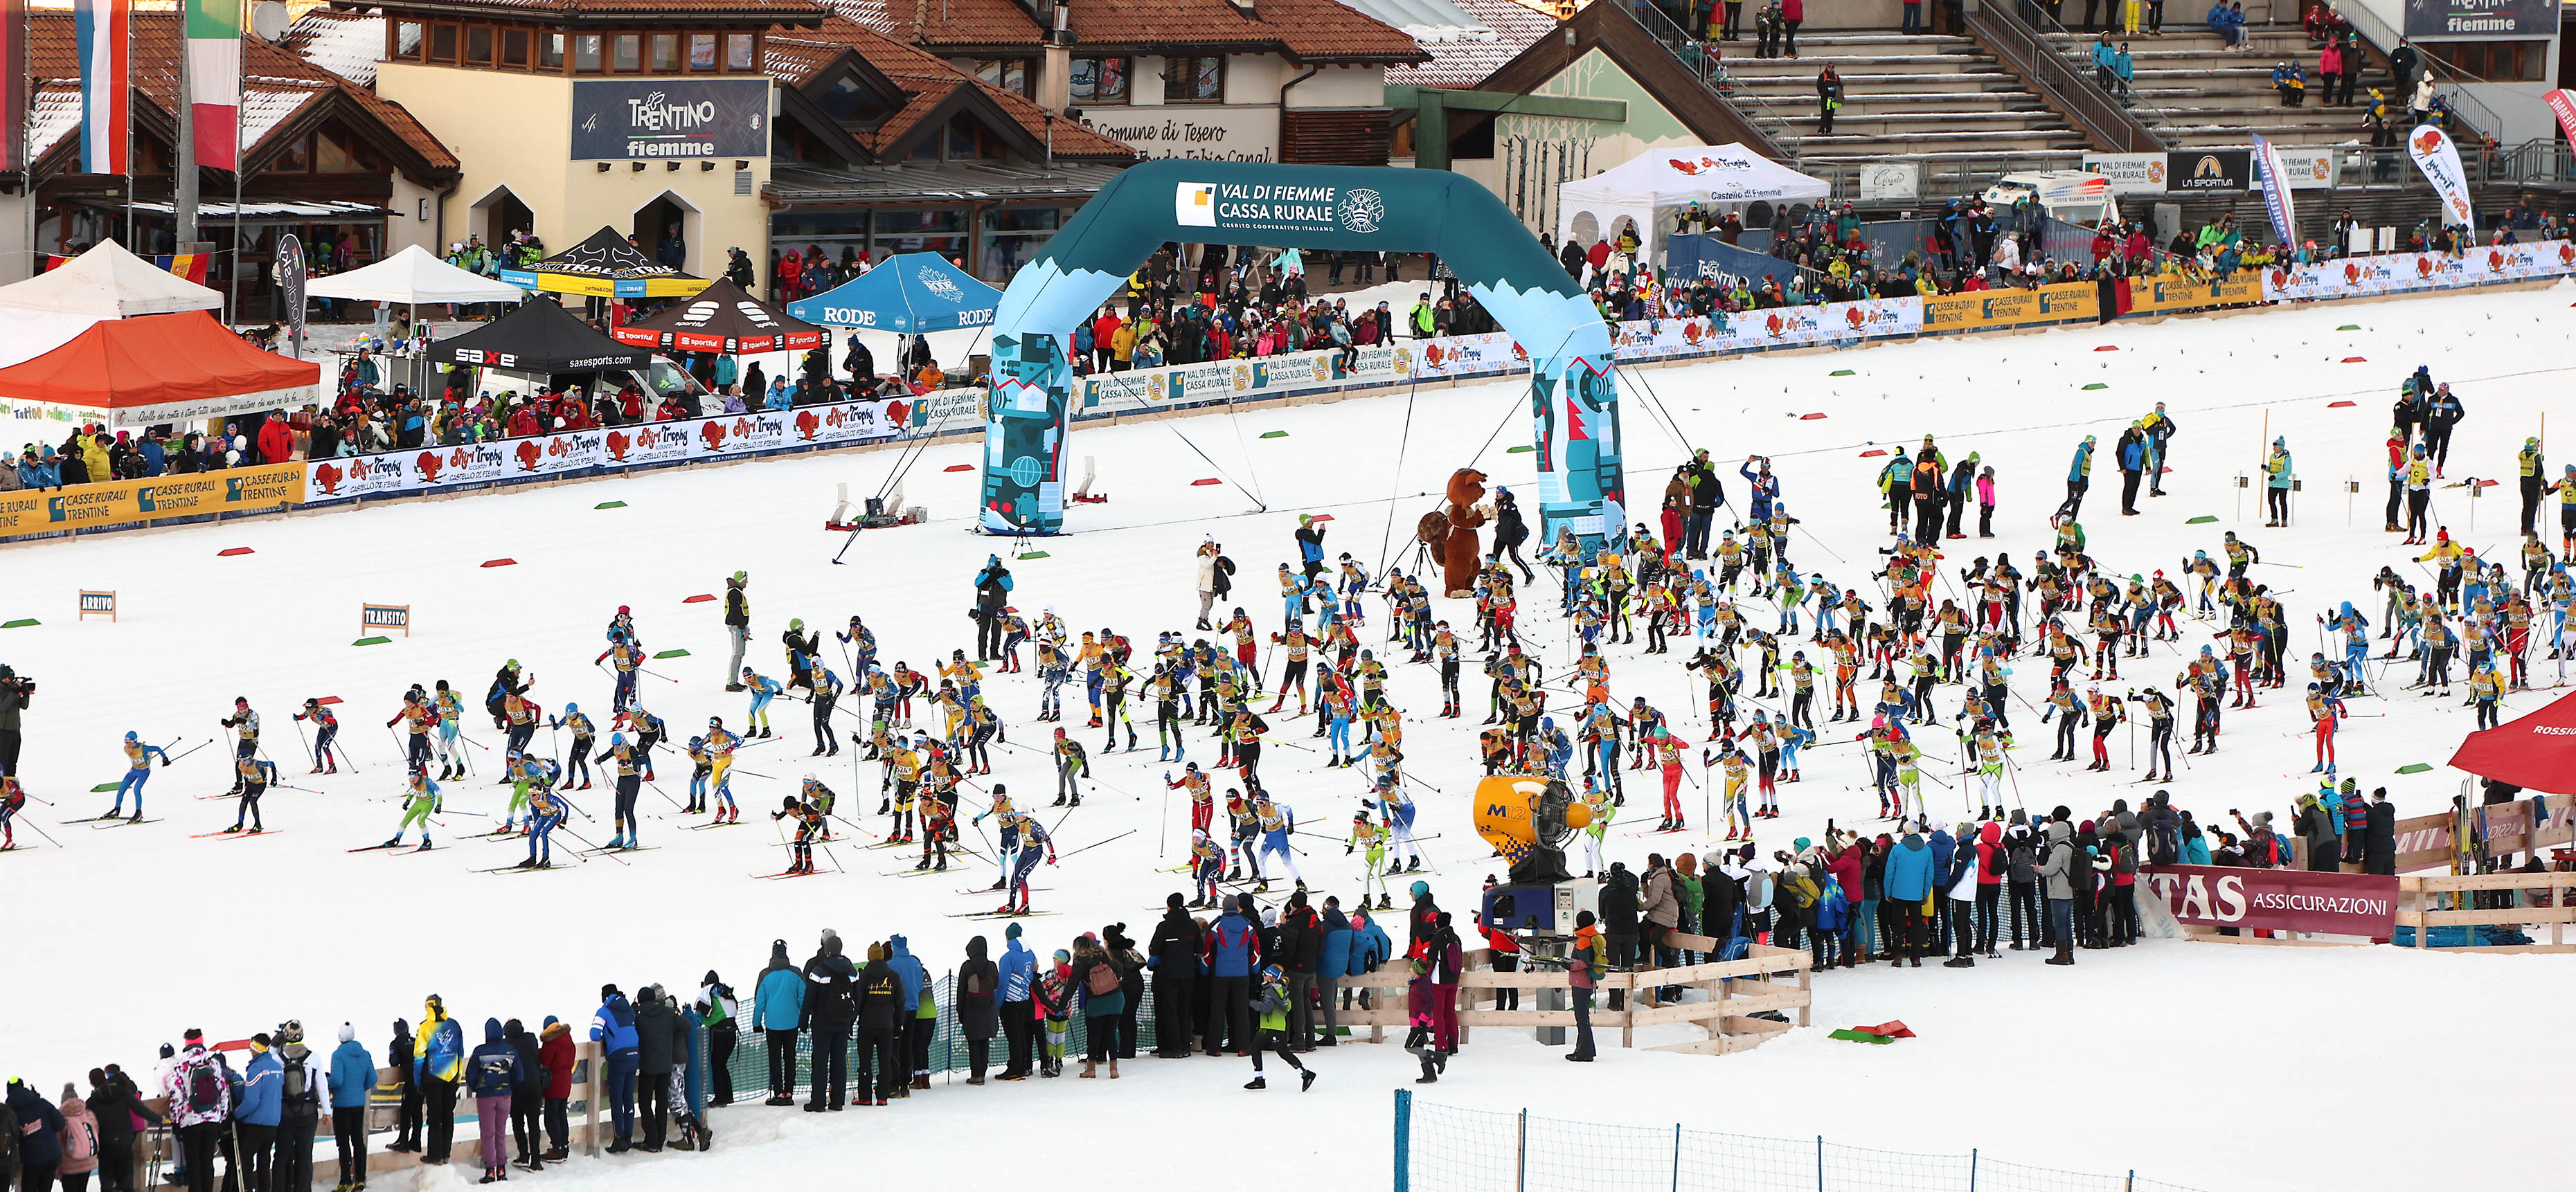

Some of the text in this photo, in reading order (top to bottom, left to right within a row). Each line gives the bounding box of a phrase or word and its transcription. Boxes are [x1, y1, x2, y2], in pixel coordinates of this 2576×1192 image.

[2448, 18, 2515, 32] fiemme
[628, 99, 715, 130] TRENTINO
[1099, 120, 1226, 142] Comune di Tesero
[627, 141, 715, 156] fiemme
[2122, 161, 2145, 170] FIEMME
[2183, 179, 2233, 187] LA SPORTIVA
[1222, 183, 1335, 202] VAL DI FIEMME
[1744, 190, 1751, 198] di
[1219, 202, 1332, 222] CASSA RURALE
[926, 280, 956, 291] RODE
[2165, 281, 2182, 290] CASSE
[2222, 286, 2247, 295] TRENTINE
[1996, 296, 2012, 307] CASSE
[2051, 291, 2068, 301] CASSE
[2165, 291, 2193, 300] TRENTINE
[1937, 302, 1953, 311] CASSE
[1994, 308, 2021, 316] TRENTINE
[2051, 302, 2077, 311] TRENTINE
[824, 307, 877, 326] RODE
[958, 309, 994, 325] RODE
[1935, 312, 1962, 323] TRENTINE
[691, 339, 717, 347] sportful
[455, 348, 515, 368] saxe
[1361, 349, 1392, 360] DI FIEMME
[569, 355, 632, 368] saxesports.com
[1269, 357, 1312, 370] VAL DI FIEMME
[1370, 360, 1391, 370] RURALE
[1187, 366, 1231, 379] VAL DI FIEMME
[1271, 369, 1312, 381] CASSA RURALE
[1121, 375, 1145, 386] FIEMME
[1186, 377, 1231, 390] CASSA RURALE
[943, 393, 976, 405] DI FIEMME
[1101, 387, 1145, 399] CASSA RURALE
[138, 410, 156, 422] Quello
[826, 405, 874, 428] Skiri Trophy
[931, 410, 950, 419] CASSA
[733, 415, 782, 439] Skiri Trophy
[637, 425, 688, 449] Skiri Trophy
[825, 431, 849, 440] CASTELLO
[548, 434, 600, 458] Skiri Trophy
[733, 442, 757, 450] CASTELLO
[450, 445, 503, 469] Skiri Trophy
[637, 452, 660, 461] CASTELLO
[350, 457, 402, 480] Skiri Trophy
[548, 459, 573, 470] CASTELLO
[245, 473, 270, 487] CASSE
[449, 473, 475, 481] CASTELLO
[156, 480, 216, 496] CASSE RURALI
[350, 482, 373, 493] CASTELLO
[66, 490, 127, 506] CASSE RURALI
[156, 496, 198, 510] TRENTINE
[8, 499, 37, 512] RURALI
[67, 506, 109, 521] TRENTINE
[82, 597, 113, 611] ARRIVO
[365, 610, 406, 626] TRANSITO
[1486, 804, 1528, 820] M12
[2253, 893, 2387, 916] ASSICURAZIONI
